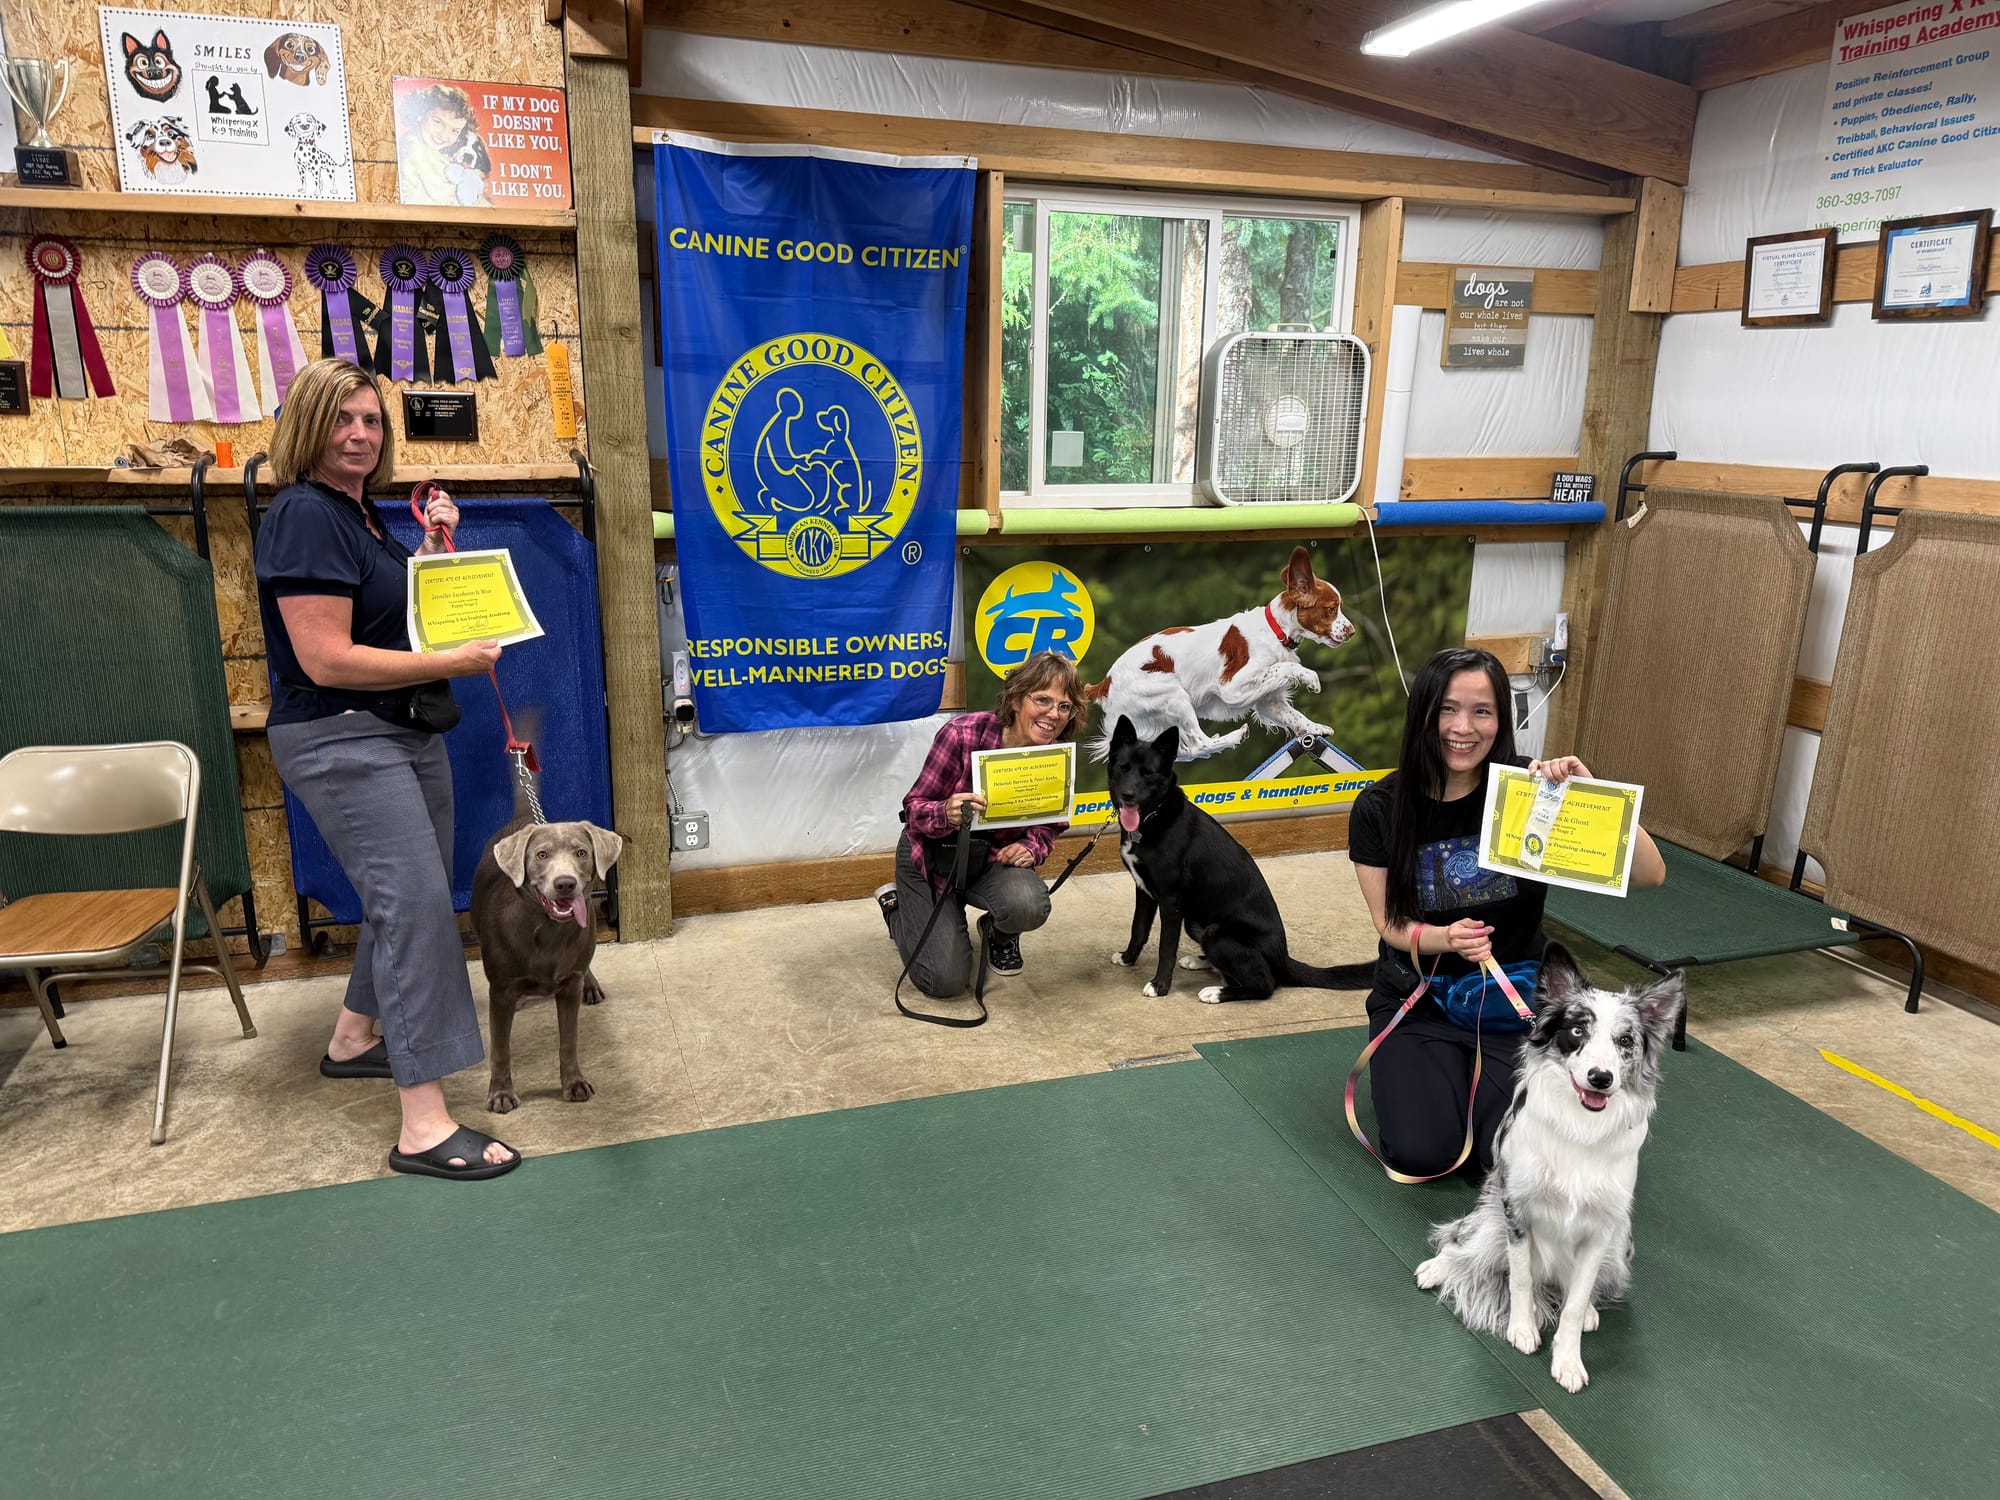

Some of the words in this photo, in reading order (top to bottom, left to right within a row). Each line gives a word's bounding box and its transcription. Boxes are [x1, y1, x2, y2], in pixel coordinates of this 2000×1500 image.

[1843, 3, 1944, 41] Whispering
[194, 44, 252, 60] SMILES
[1840, 33, 1911, 62] Training
[1835, 75, 1870, 92] Positive
[1873, 58, 1953, 82] Reinforcement
[1956, 50, 1991, 66] Group
[482, 95, 498, 110] IF
[502, 96, 526, 111] MY
[529, 97, 560, 113] DOG
[1832, 98, 1851, 110] and
[1853, 91, 1884, 108] private
[1887, 81, 1933, 97] classes!
[1841, 113, 1878, 127] Puppies,
[1881, 101, 1943, 117] Obedience,
[1946, 92, 1977, 107] Rally,
[211, 116, 251, 128] Whispering
[253, 119, 258, 127] X
[492, 114, 553, 132] DOESN'T
[1836, 130, 1878, 145] Treibball,
[1880, 118, 1938, 136] Behavioral
[1941, 112, 1976, 127] Issues
[212, 126, 226, 135] K-9
[229, 128, 258, 139] Training
[488, 133, 526, 149] LIKE
[529, 135, 562, 154] YOU,
[1832, 146, 1874, 162] Certified
[1876, 142, 1895, 155] AKC
[1897, 136, 1938, 150] Canine
[1941, 130, 1969, 144] Good
[499, 163, 506, 177] I
[509, 163, 553, 180] DON'T
[1830, 168, 1849, 181] and
[1853, 163, 1875, 177] Trick
[1878, 156, 1924, 172] Evaluator
[491, 181, 529, 197] LIKE
[532, 183, 566, 199] YOU.
[1816, 185, 1902, 209] 360-393-7097
[669, 226, 770, 259] CANINE
[776, 239, 854, 264] GOOD
[1910, 238, 1953, 248] CERTIFICATE
[1773, 259, 1802, 267] CERTIFICATE
[1797, 250, 1816, 258] CLASSIC
[1464, 272, 1509, 309] dogs
[1511, 299, 1525, 307] not
[1460, 312, 1475, 320] our
[1477, 311, 1499, 320] whole
[1502, 311, 1523, 320] lives
[1474, 322, 1487, 331] but
[1490, 323, 1508, 333] they
[1463, 347, 1485, 356] lives
[1487, 347, 1510, 357] whole
[705, 358, 761, 478] CANINE
[764, 338, 855, 367] GOOD
[860, 362, 918, 484] CITIZEN
[1556, 474, 1561, 482] A
[1553, 488, 1590, 502] HEART
[788, 519, 809, 551] AMERICAN
[810, 519, 833, 533] KENNEL
[797, 528, 831, 566] AKC
[687, 637, 839, 658] RESPONSIBLE
[845, 630, 947, 653] OWNERS,
[985, 616, 1084, 665] CR
[890, 656, 949, 679] DOGS
[1194, 790, 1236, 805] dogs
[1240, 788, 1253, 801] &
[1257, 781, 1330, 799] handlers
[1566, 799, 1612, 812] ACHIEVEMENT
[1570, 817, 1590, 827] Ghost
[1553, 842, 1579, 852] Training
[1579, 846, 1607, 857] Academy
